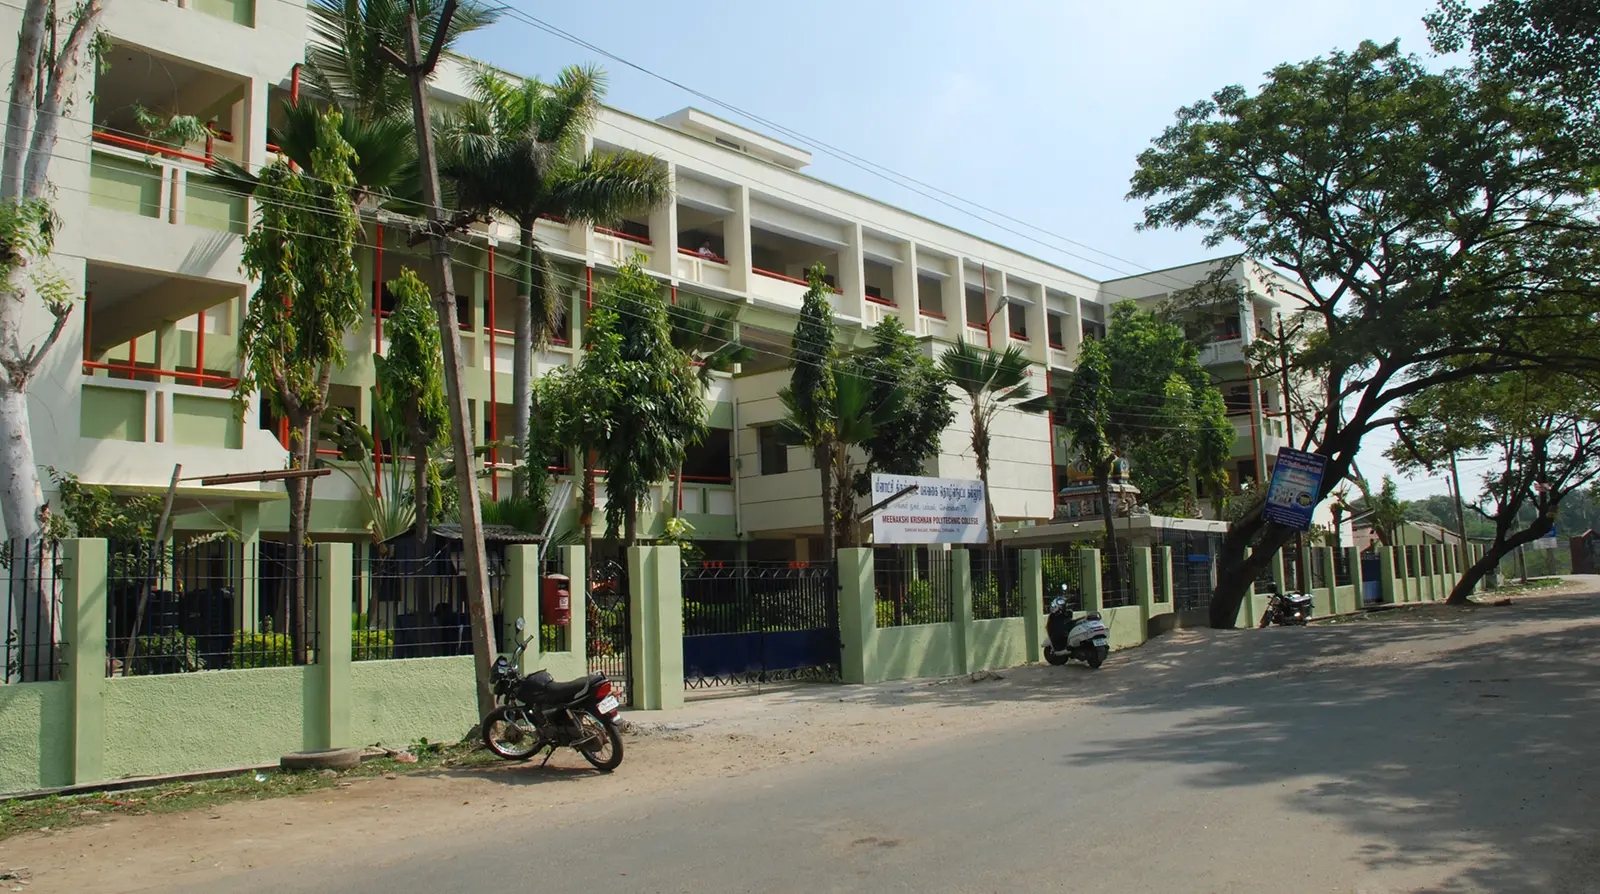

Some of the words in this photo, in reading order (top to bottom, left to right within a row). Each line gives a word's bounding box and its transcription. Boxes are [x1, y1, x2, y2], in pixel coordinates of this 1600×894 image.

[882, 515, 909, 524] MEENAKSHI
[910, 516, 932, 524] KRISHNAN
[933, 516, 961, 525] POLYTECHNIC
[961, 517, 979, 525] COLLEGE
